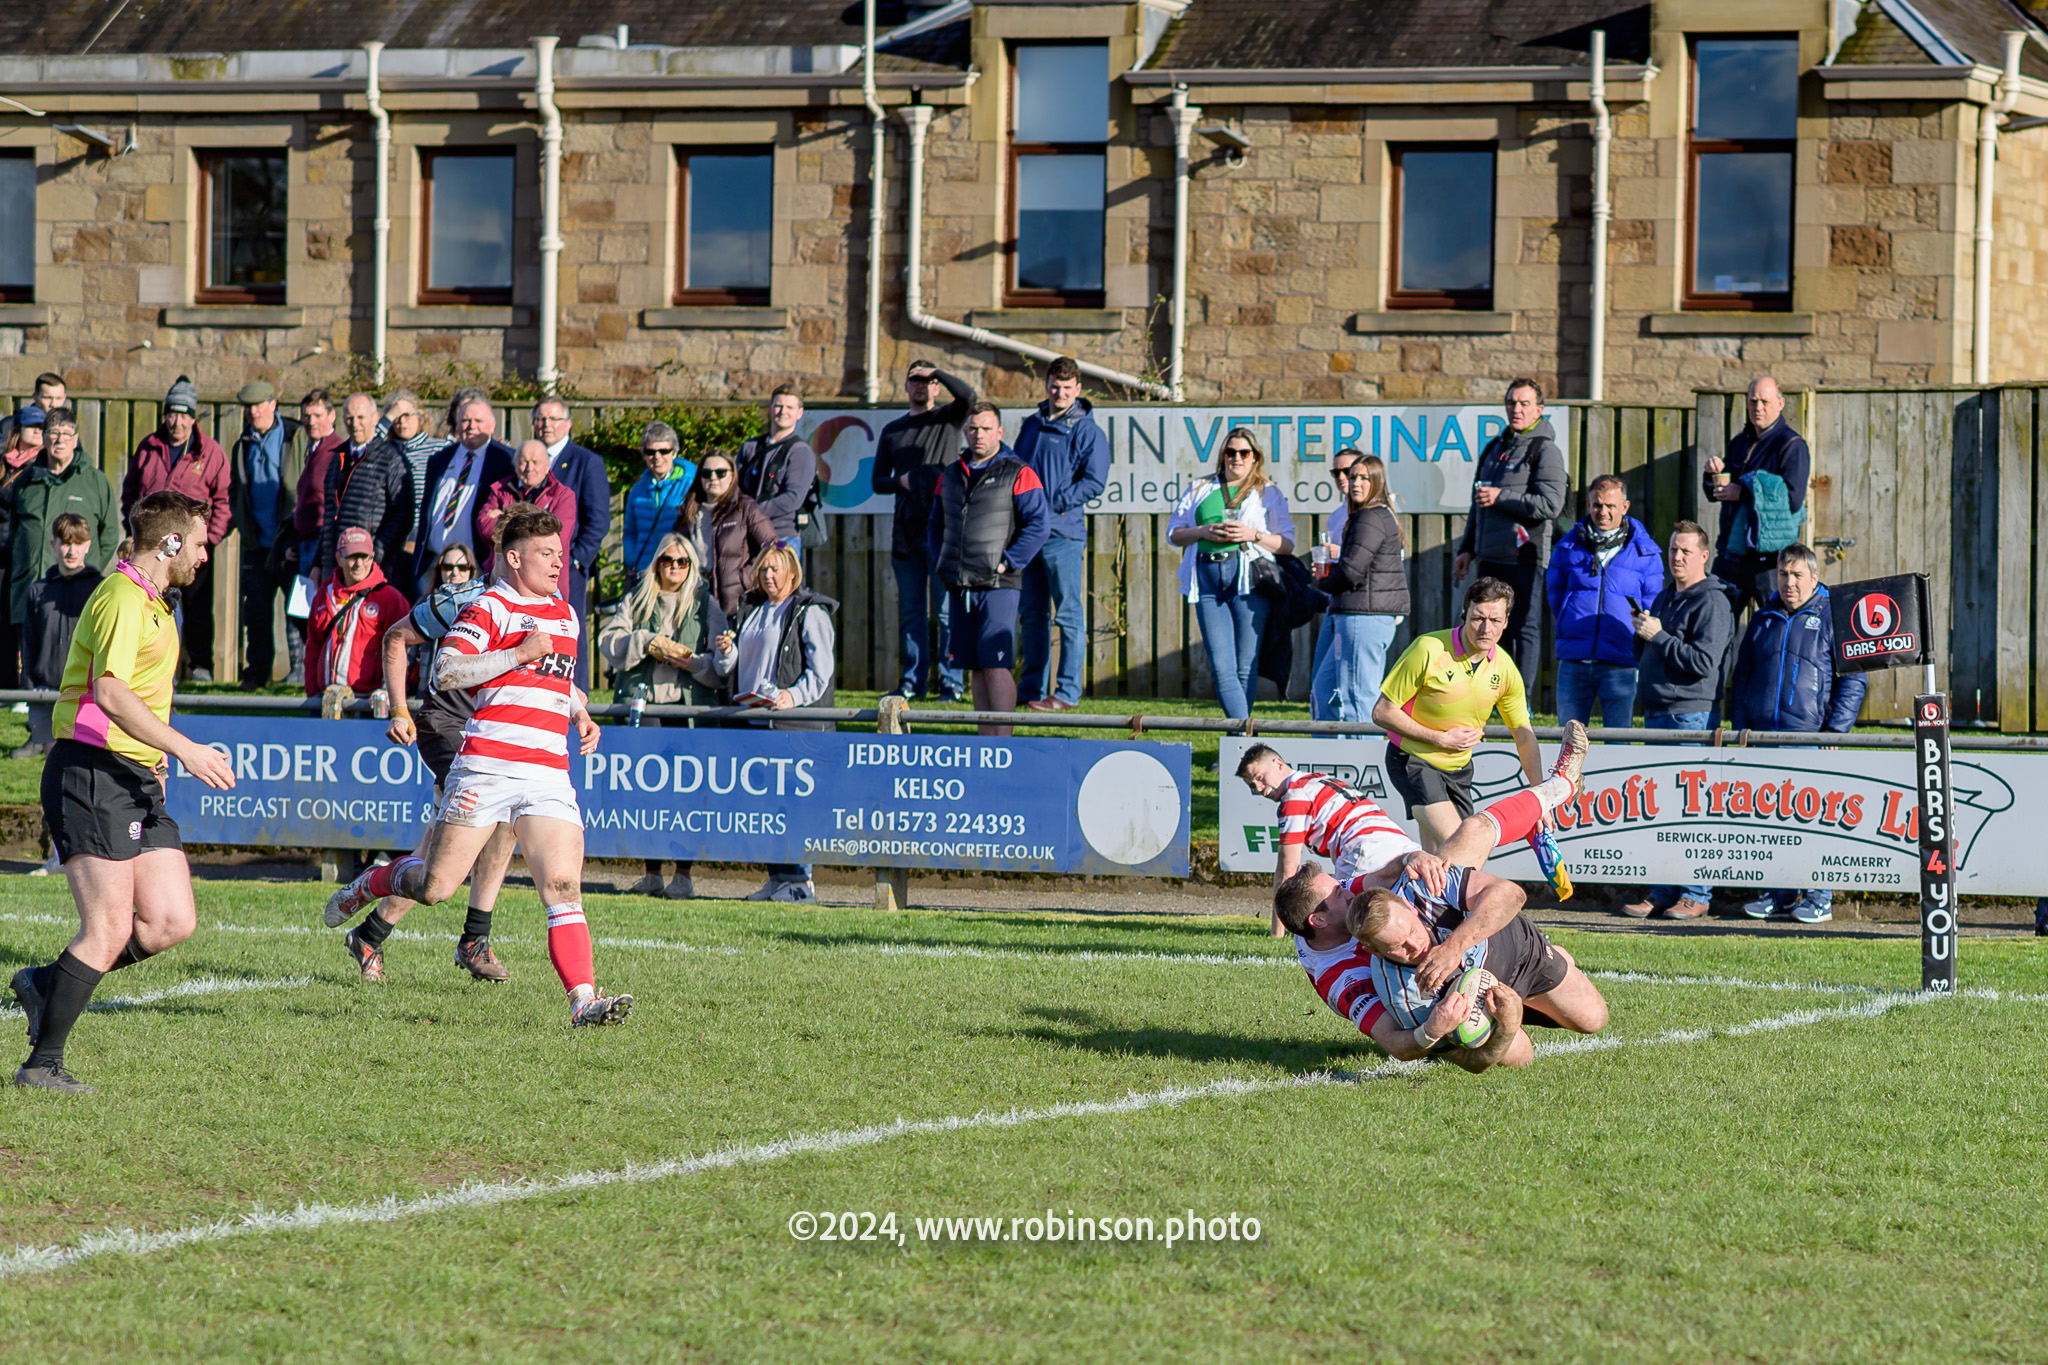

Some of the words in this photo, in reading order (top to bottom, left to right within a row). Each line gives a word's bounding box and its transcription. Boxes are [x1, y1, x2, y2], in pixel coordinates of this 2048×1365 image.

[1184, 414, 1552, 463] VTERINAR
[847, 743, 971, 768] JEDBURGH
[980, 747, 1013, 769] RD
[584, 753, 815, 797] PRODUCTS
[894, 777, 965, 800] KELSO
[1676, 769, 1865, 831] Tractors
[201, 795, 290, 819] PRECAST
[297, 798, 412, 823] CONCRETE
[585, 808, 786, 835] MANUFACTURERS
[833, 808, 864, 830] Tel
[871, 810, 937, 833] 01573
[945, 813, 1026, 835] 224393
[804, 837, 1055, 860] SALES@BORDERCONCRETE.CO.UK
[1657, 831, 1803, 846] BERWICK-UPON-TWEED
[1583, 848, 1623, 860] KELSO
[1685, 848, 1723, 860] 01289
[1727, 850, 1773, 861] 331904
[1821, 855, 1892, 868] MACMERRY
[1601, 864, 1647, 877] 225213
[1693, 868, 1764, 881] SWARLAND
[1811, 871, 1851, 883] 01875
[1854, 872, 1901, 884] 617323
